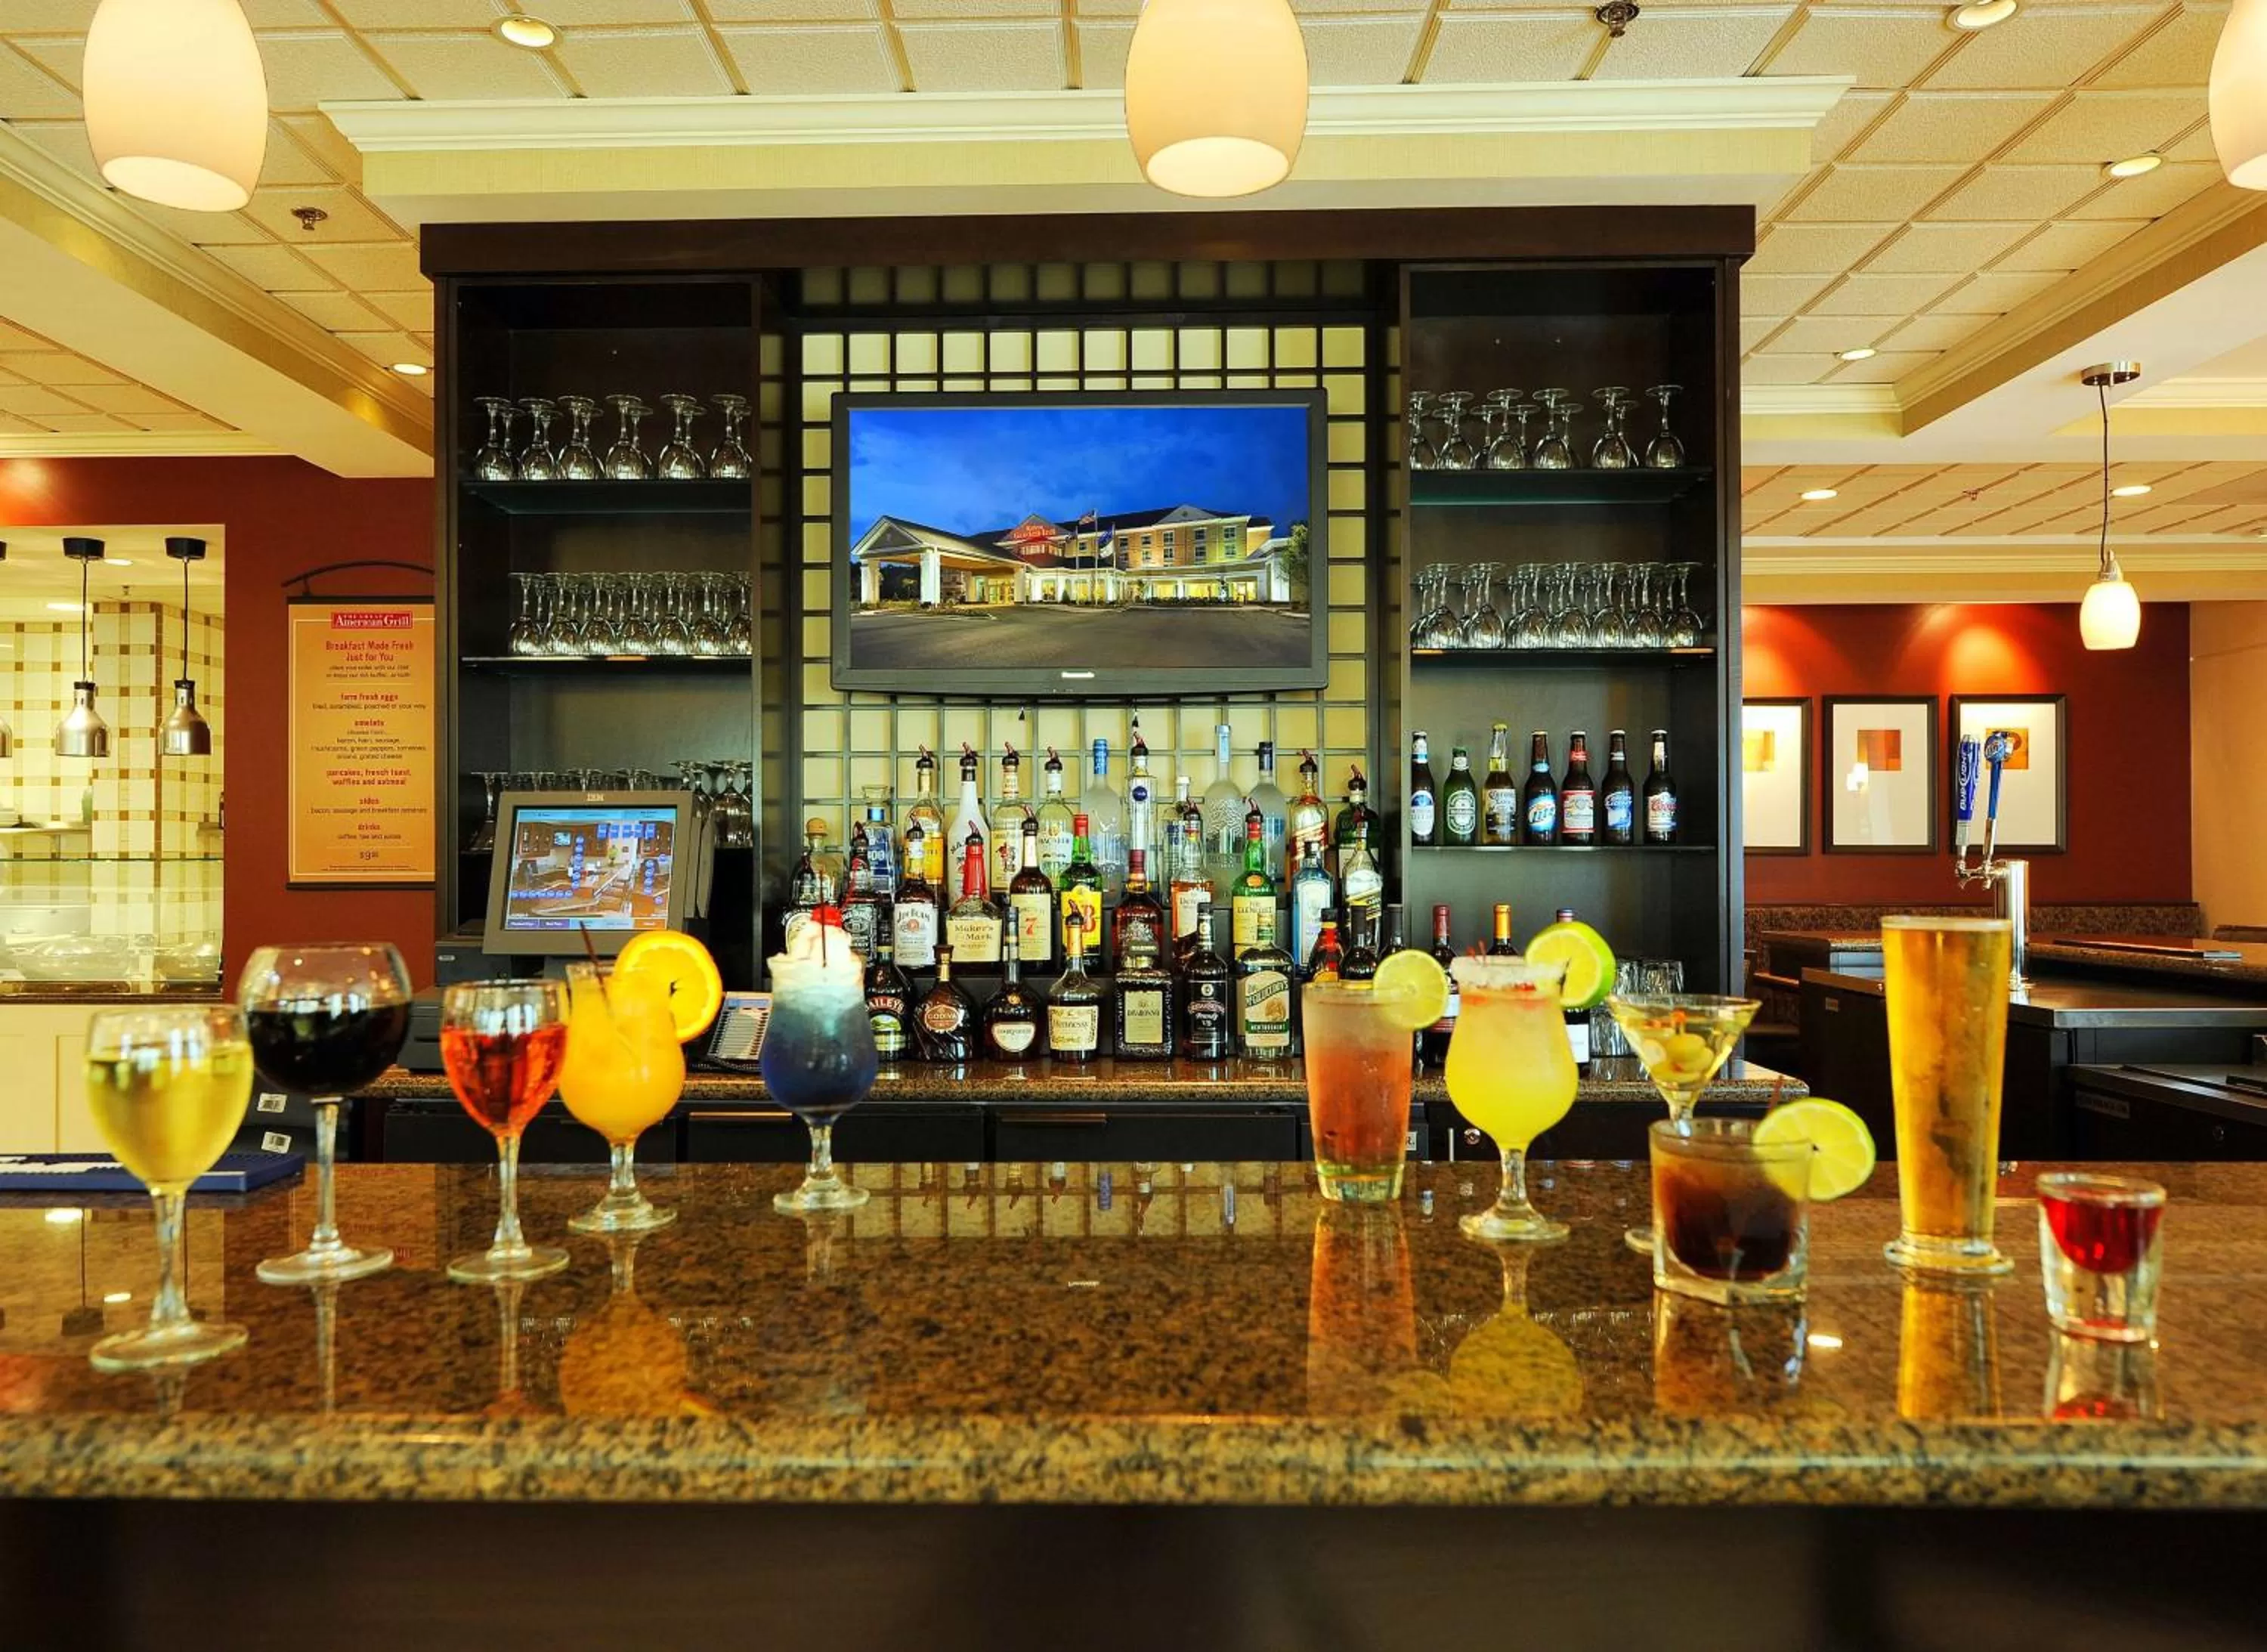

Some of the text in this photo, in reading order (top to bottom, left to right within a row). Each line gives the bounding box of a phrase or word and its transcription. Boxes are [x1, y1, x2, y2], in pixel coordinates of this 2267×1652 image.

[336, 614, 409, 626] American Grill
[326, 640, 414, 651] Breakfast Made Fresh
[346, 652, 394, 661] Just for You
[359, 692, 379, 701] fresh
[954, 923, 994, 933] Maker's
[1025, 917, 1038, 936] 7
